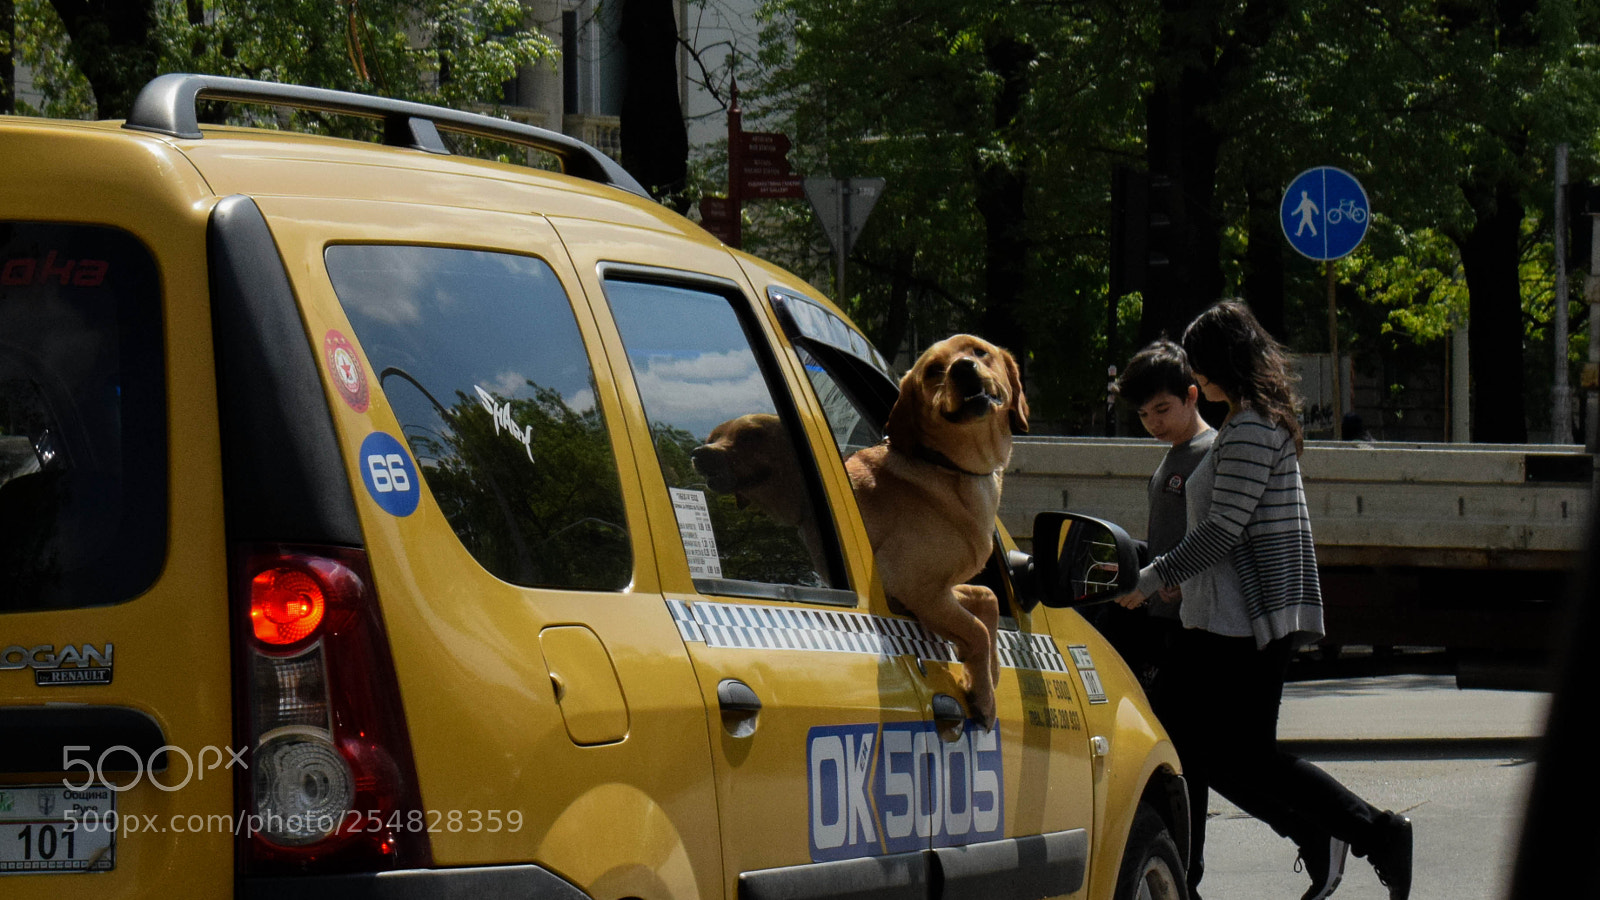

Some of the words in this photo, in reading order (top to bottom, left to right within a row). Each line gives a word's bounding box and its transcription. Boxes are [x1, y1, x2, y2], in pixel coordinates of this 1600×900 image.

[367, 453, 410, 492] 66
[0, 643, 113, 669] OGAN
[51, 671, 106, 681] RENAULT
[63, 789, 108, 802] Община
[811, 732, 877, 850] OK
[882, 730, 999, 838] 5005
[72, 803, 98, 816] Русе
[18, 824, 74, 860] 101
